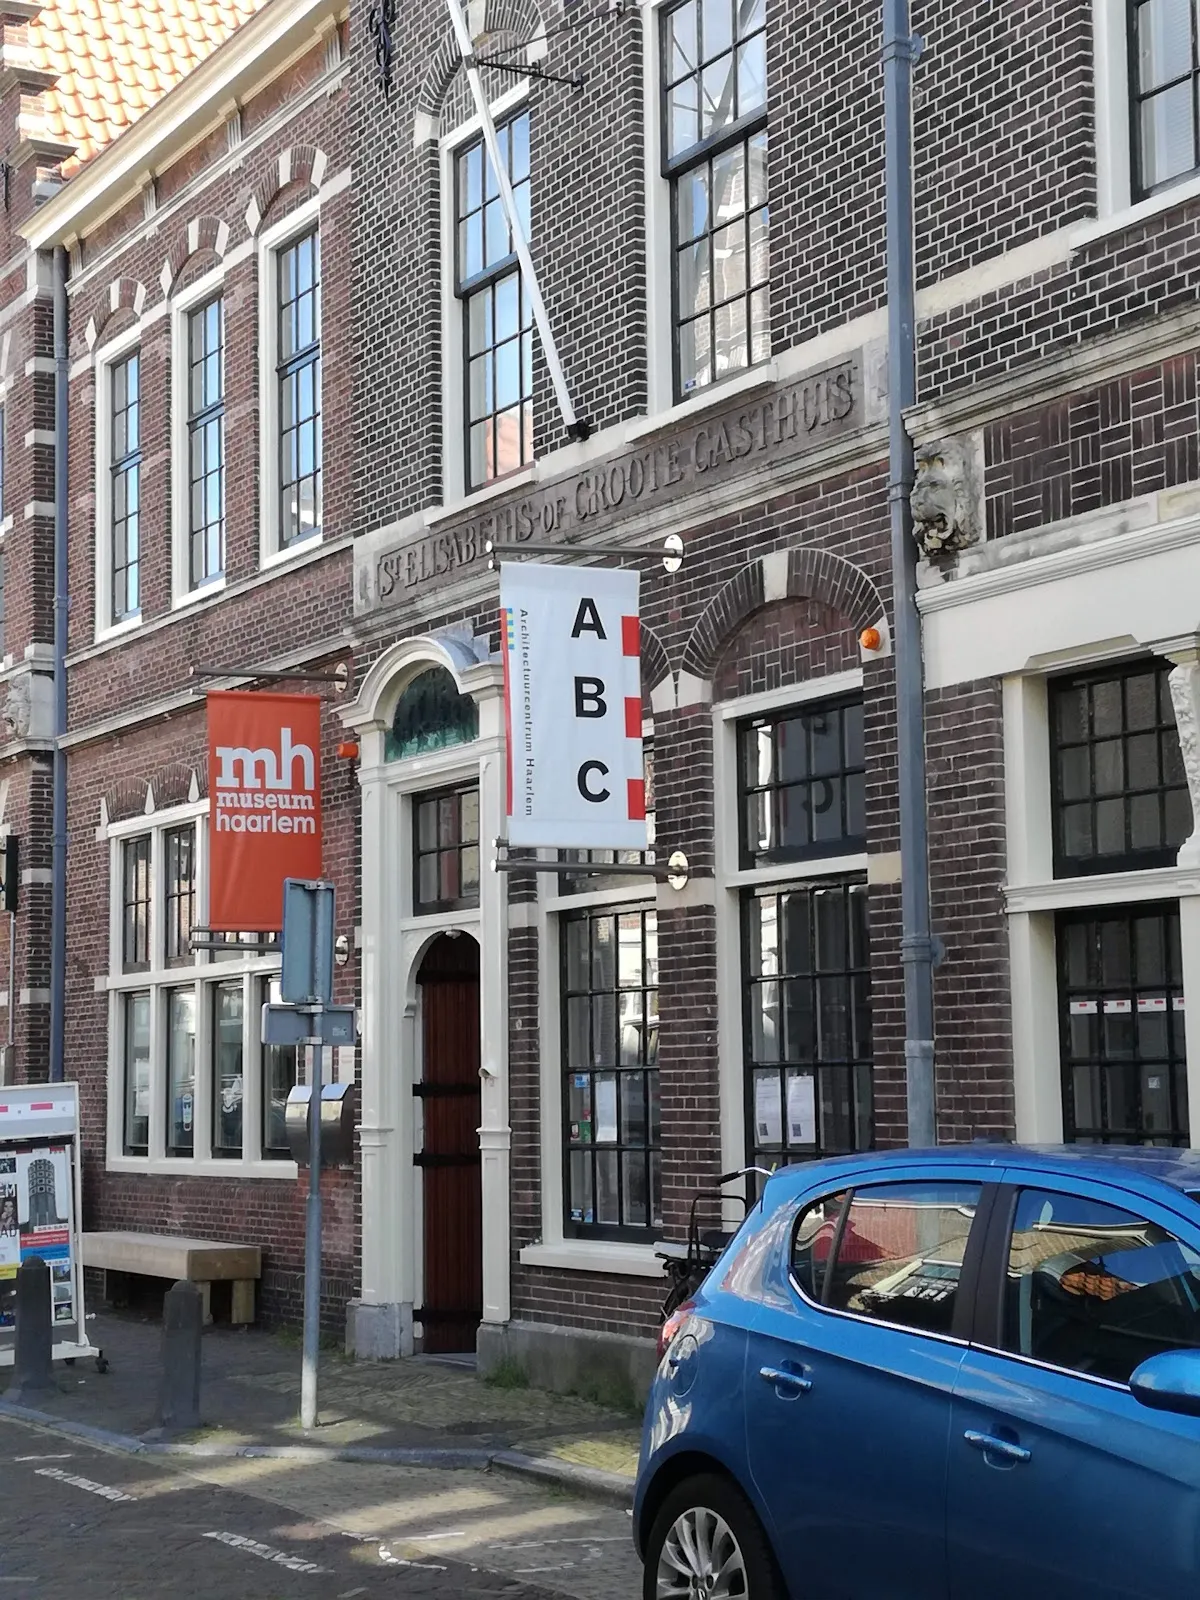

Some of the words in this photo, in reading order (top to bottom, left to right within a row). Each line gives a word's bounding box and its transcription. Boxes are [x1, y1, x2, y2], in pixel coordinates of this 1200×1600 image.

[571, 598, 608, 640] A
[519, 608, 535, 752] Architectuurcentrum
[574, 676, 608, 719] B
[215, 727, 315, 791] mh
[216, 791, 315, 810] museum
[525, 757, 536, 816] Haarlem
[577, 760, 611, 803] C
[216, 808, 316, 834] haarlem
